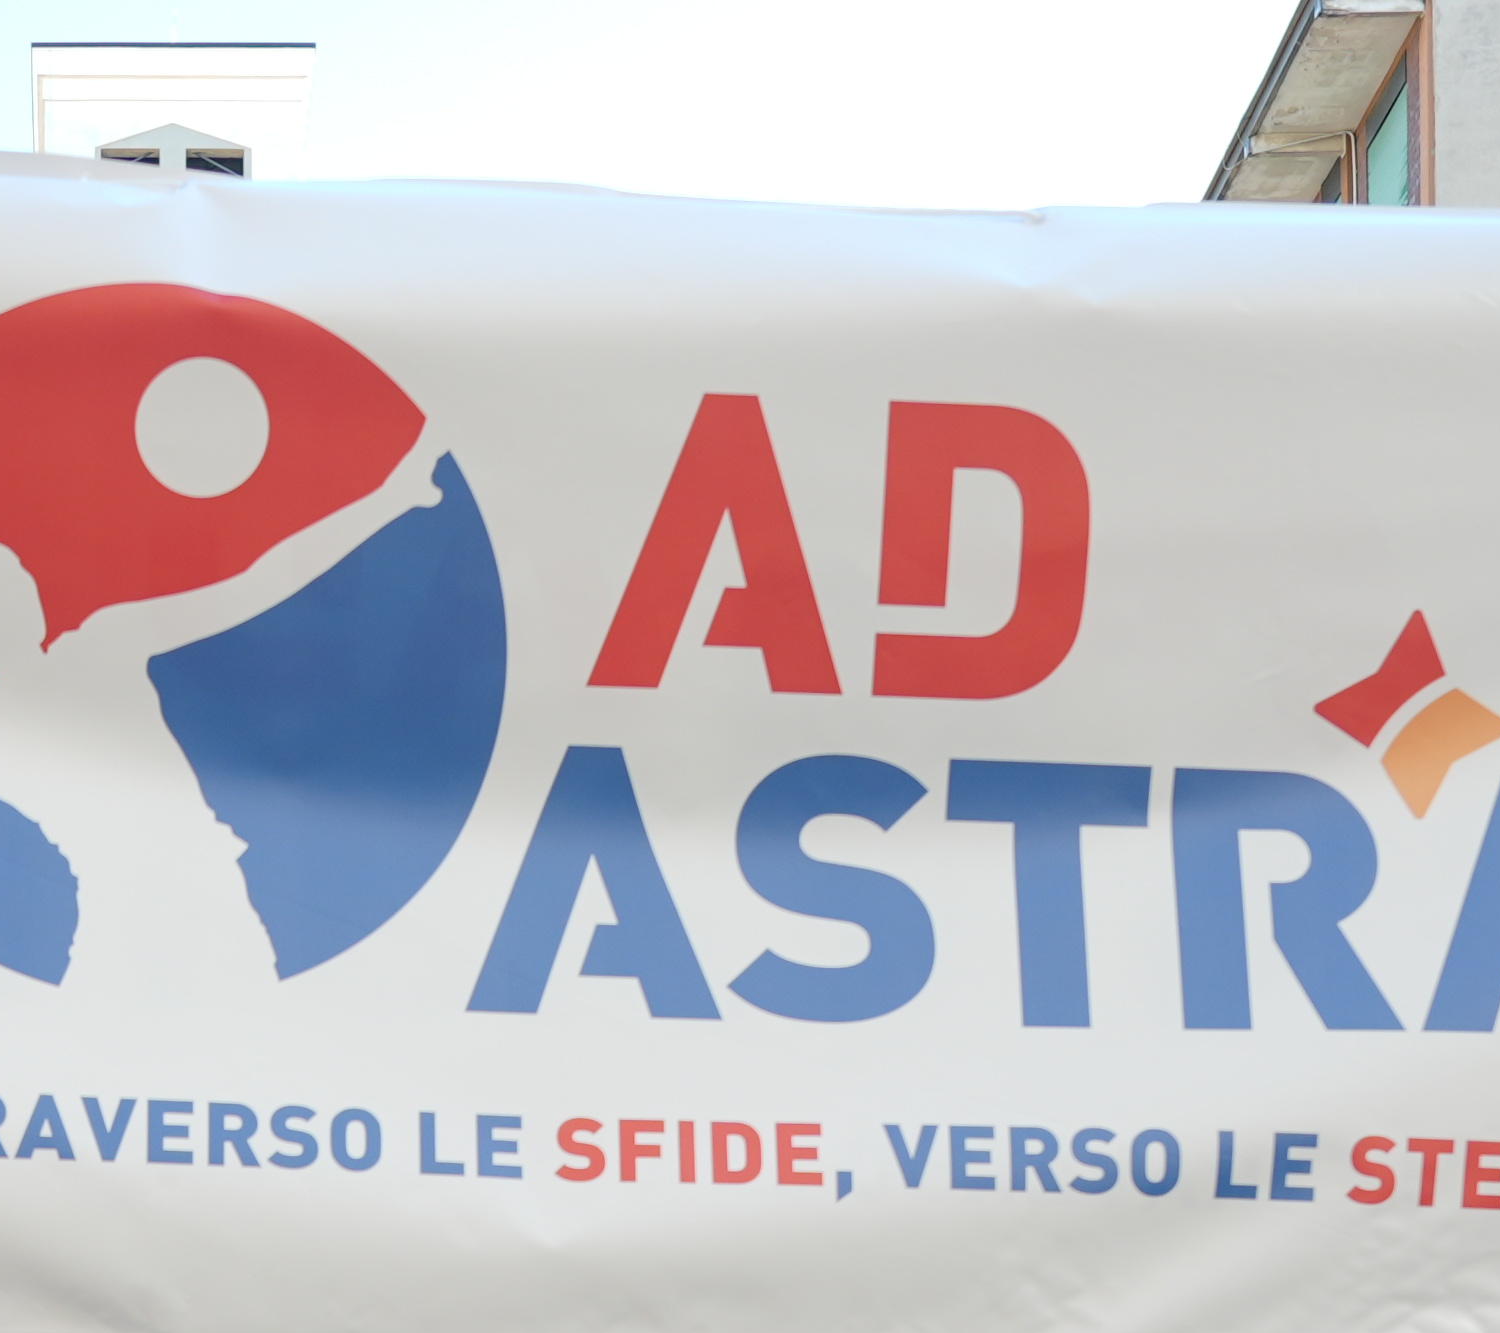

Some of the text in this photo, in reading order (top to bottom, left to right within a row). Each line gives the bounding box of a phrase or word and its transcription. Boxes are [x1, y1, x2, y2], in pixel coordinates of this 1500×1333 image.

[586, 393, 1092, 701] AD
[418, 1112, 525, 1181] LE
[553, 1118, 857, 1203] SFIDE,
[884, 1123, 1184, 1200] VERSO
[1212, 1133, 1320, 1205] LE
